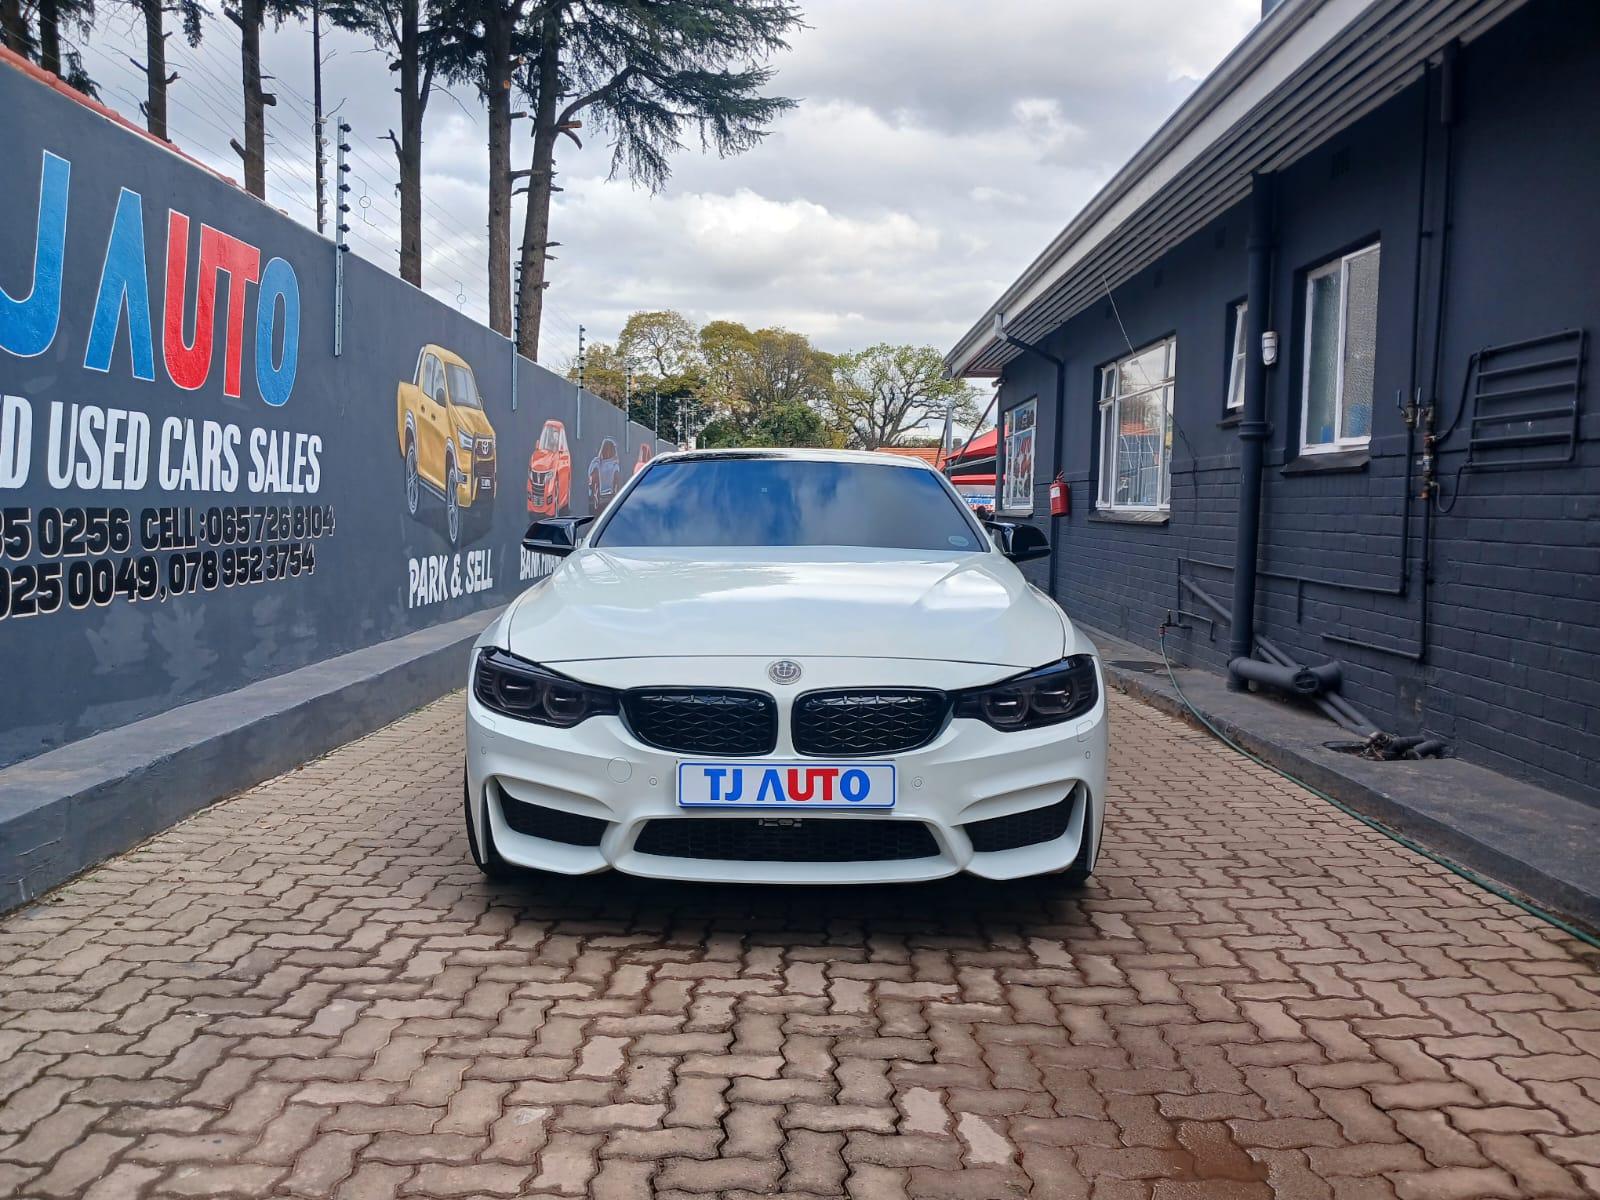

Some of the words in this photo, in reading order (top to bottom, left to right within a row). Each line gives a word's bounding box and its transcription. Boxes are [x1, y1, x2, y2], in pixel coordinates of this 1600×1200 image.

[83, 186, 300, 407] AUTO
[0, 394, 33, 489] D
[48, 401, 151, 491] USED
[158, 416, 241, 493] CARS
[248, 427, 322, 493] SALES
[0, 507, 31, 561] 5
[38, 507, 132, 559] 0256
[409, 555, 449, 609] PARK
[450, 553, 464, 599] &
[465, 549, 493, 594] SELL
[704, 768, 743, 801] TJ
[756, 768, 871, 802] AUTO
